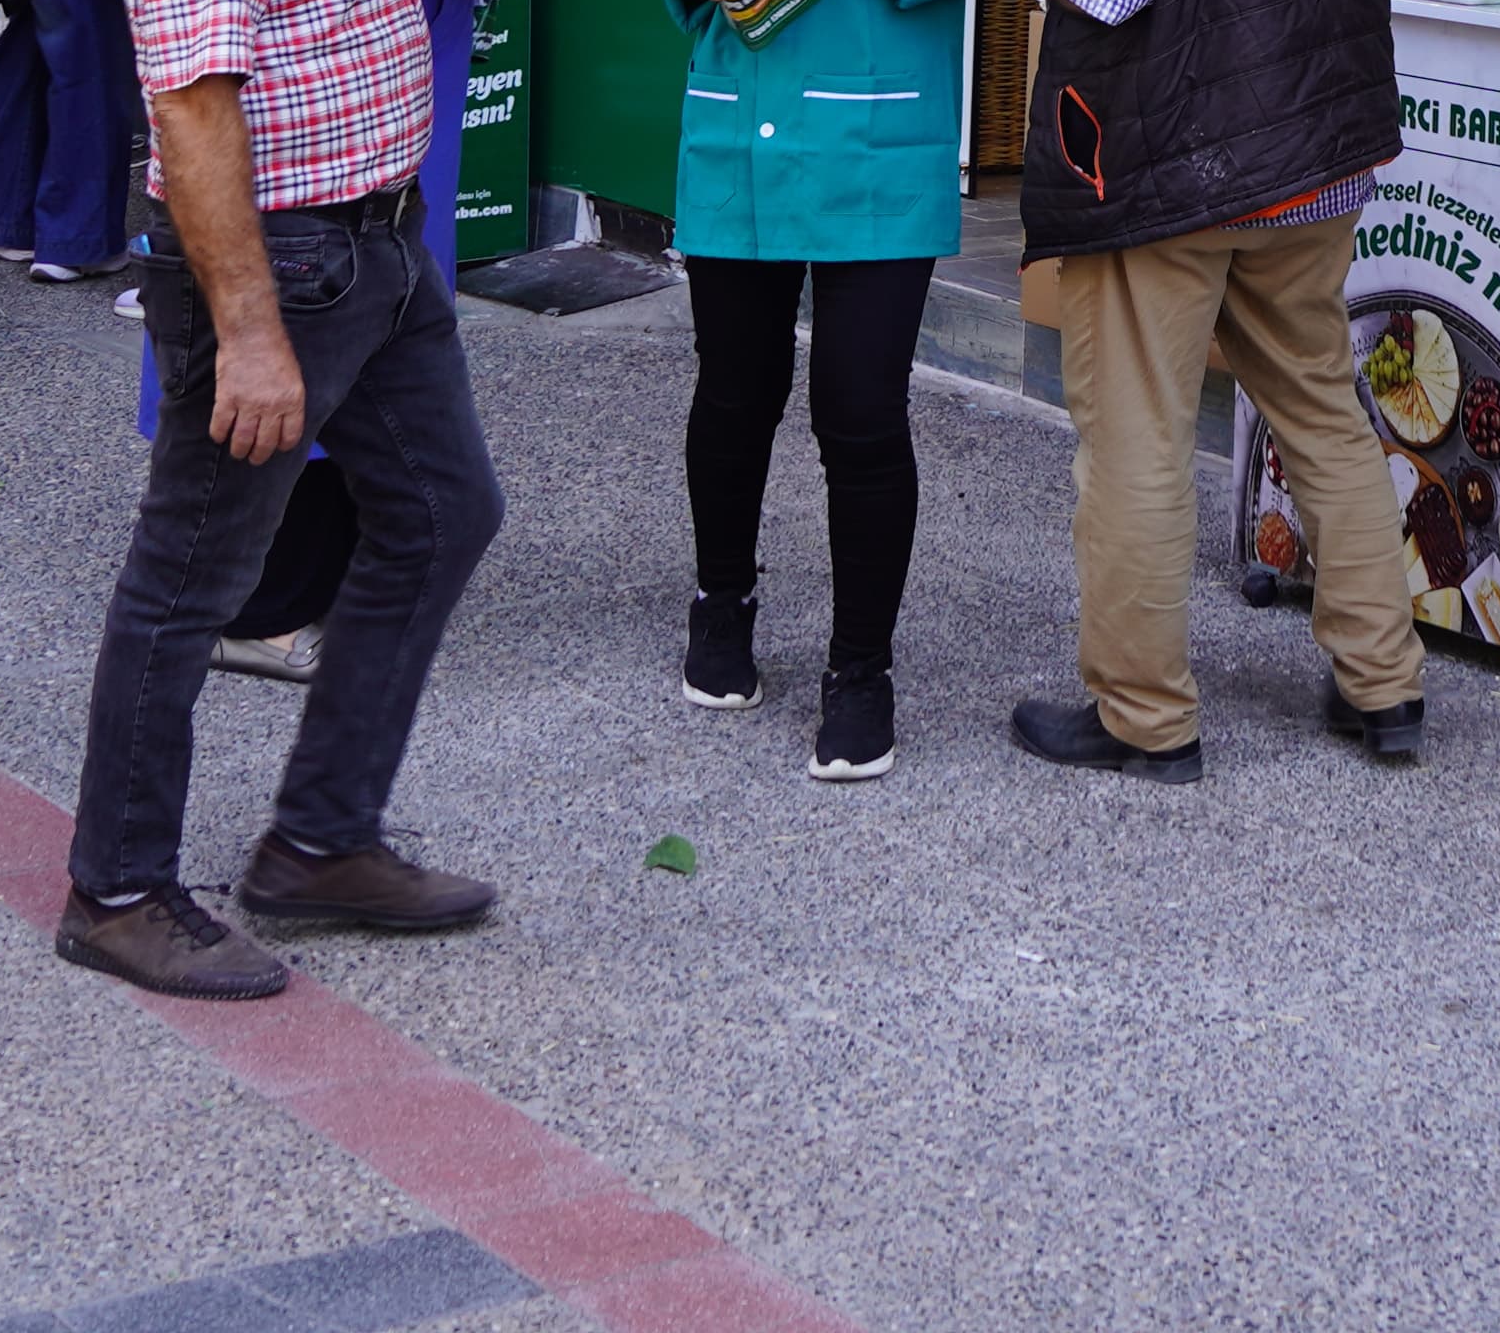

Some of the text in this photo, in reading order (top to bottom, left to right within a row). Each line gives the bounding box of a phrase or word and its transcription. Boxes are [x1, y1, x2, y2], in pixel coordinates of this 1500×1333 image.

[465, 68, 524, 102] eyen
[1400, 93, 1440, 133] RCİ
[1373, 180, 1423, 202] resel
